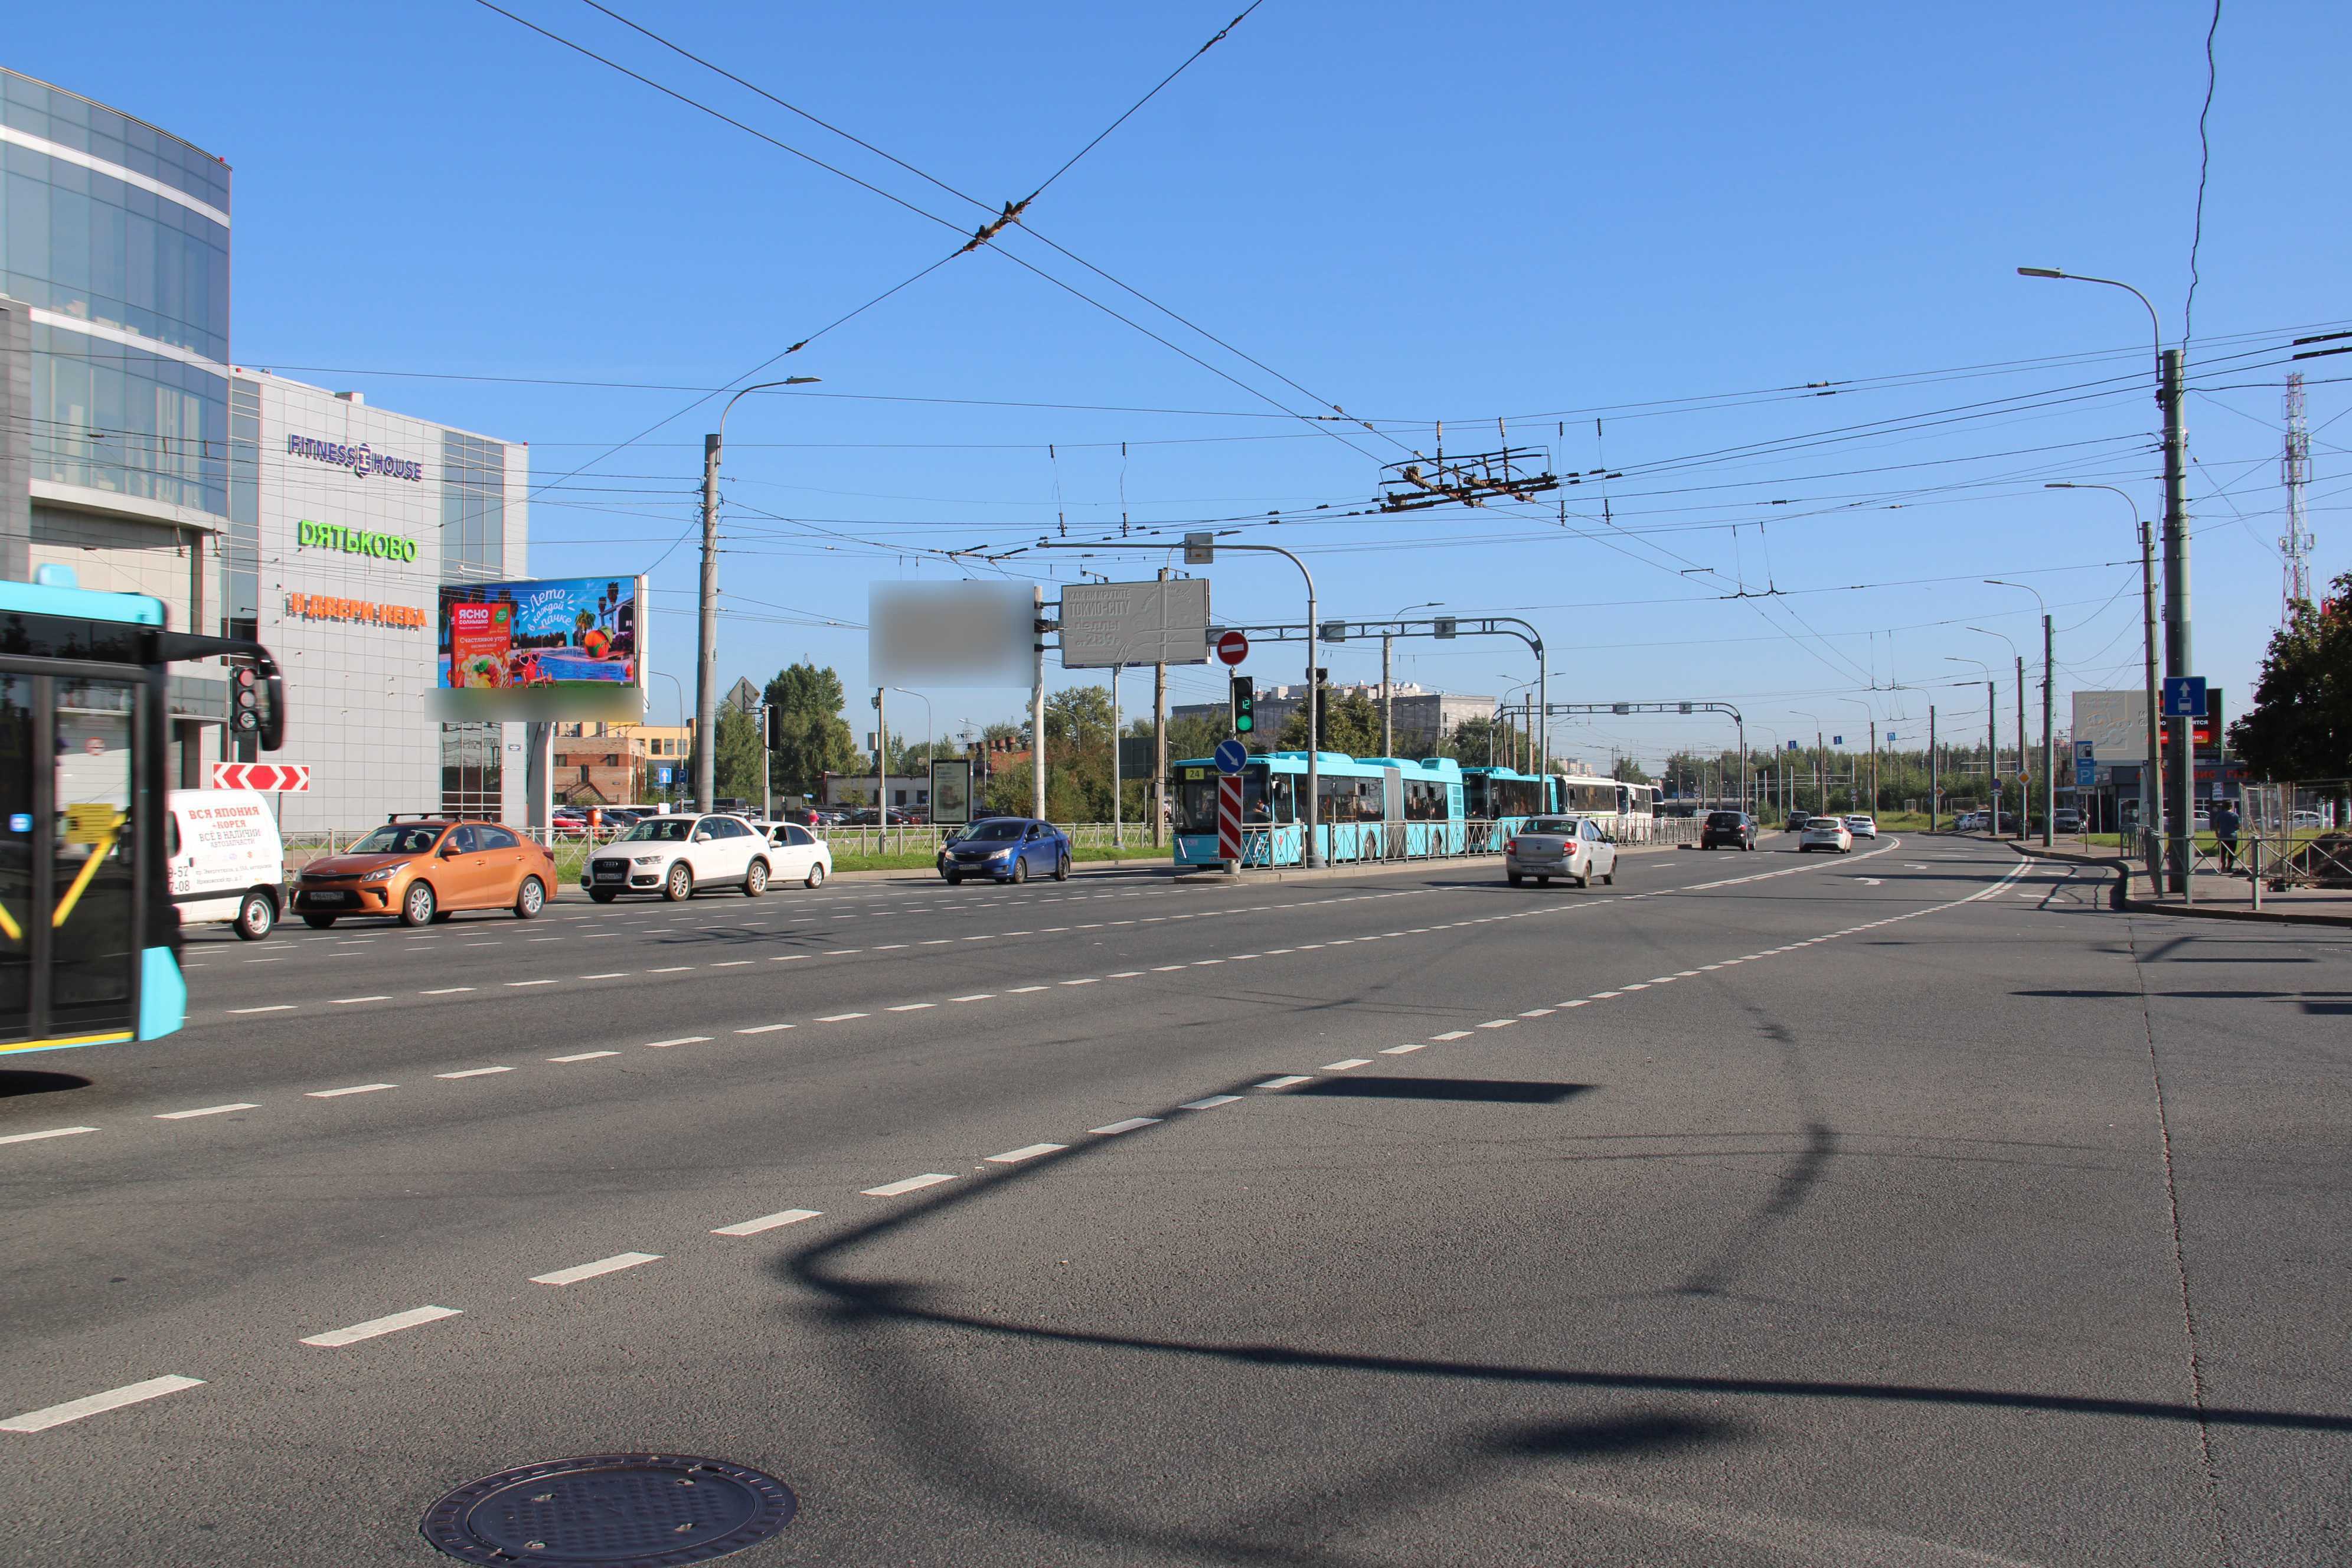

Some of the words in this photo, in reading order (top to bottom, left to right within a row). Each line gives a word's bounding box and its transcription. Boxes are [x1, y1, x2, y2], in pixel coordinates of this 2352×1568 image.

[289, 434, 355, 466] FITNESS
[371, 452, 423, 481] HOUSE
[530, 589, 566, 613] Лето
[1069, 590, 1085, 601] КАК
[1097, 589, 1131, 600] КРУТИТЕ
[309, 595, 374, 620] ДВЕРИ
[380, 604, 429, 627] НЕВА
[459, 609, 489, 619] ЯСНО
[533, 601, 564, 624] каждой
[1069, 600, 1130, 617] ТОКИО-CITY
[541, 614, 572, 627] пачке
[1242, 700, 1250, 709] 12
[1190, 770, 1200, 778] 24
[188, 809, 213, 820] ВСЯ
[214, 806, 260, 818] ЯПОНИЯ
[217, 832, 223, 841] В
[224, 828, 262, 839] НАЛИЧИИ
[210, 838, 256, 848] АВТОЗАПЧАСТИ
